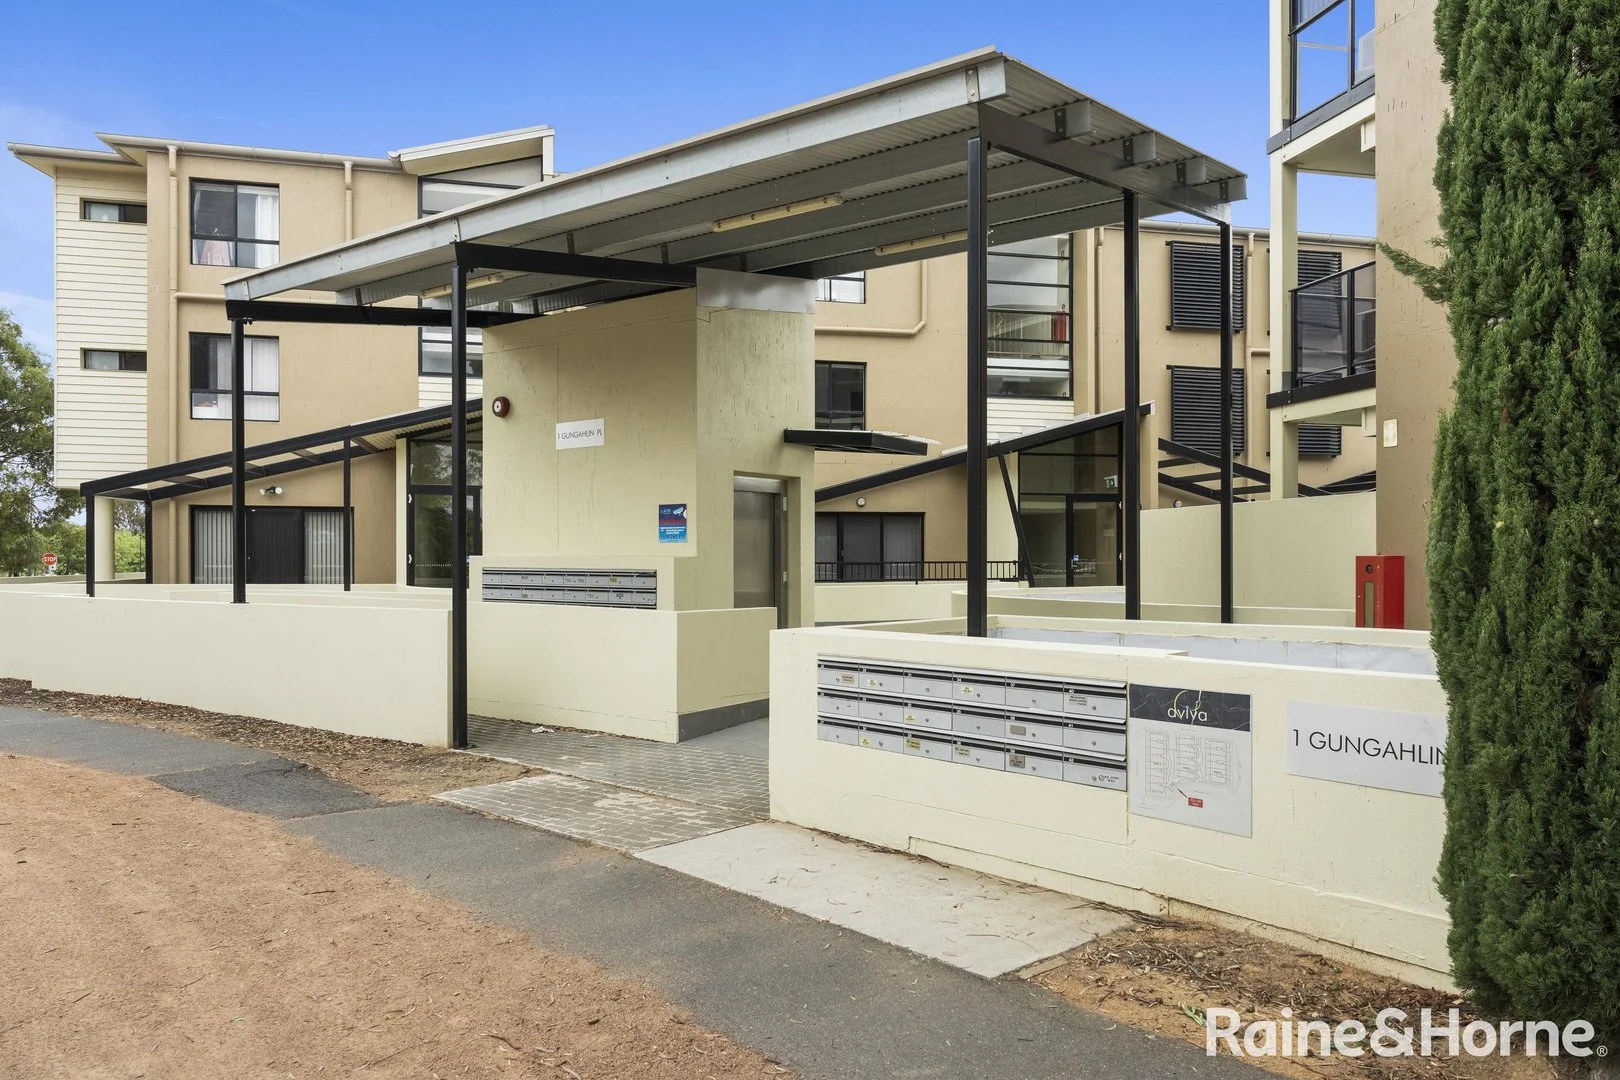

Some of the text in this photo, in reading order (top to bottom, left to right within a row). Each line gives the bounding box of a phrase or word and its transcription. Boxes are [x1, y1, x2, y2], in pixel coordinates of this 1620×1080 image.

[561, 430, 595, 440] GUNGAHLIN
[596, 428, 603, 436] PL
[1293, 729, 1299, 747] 1
